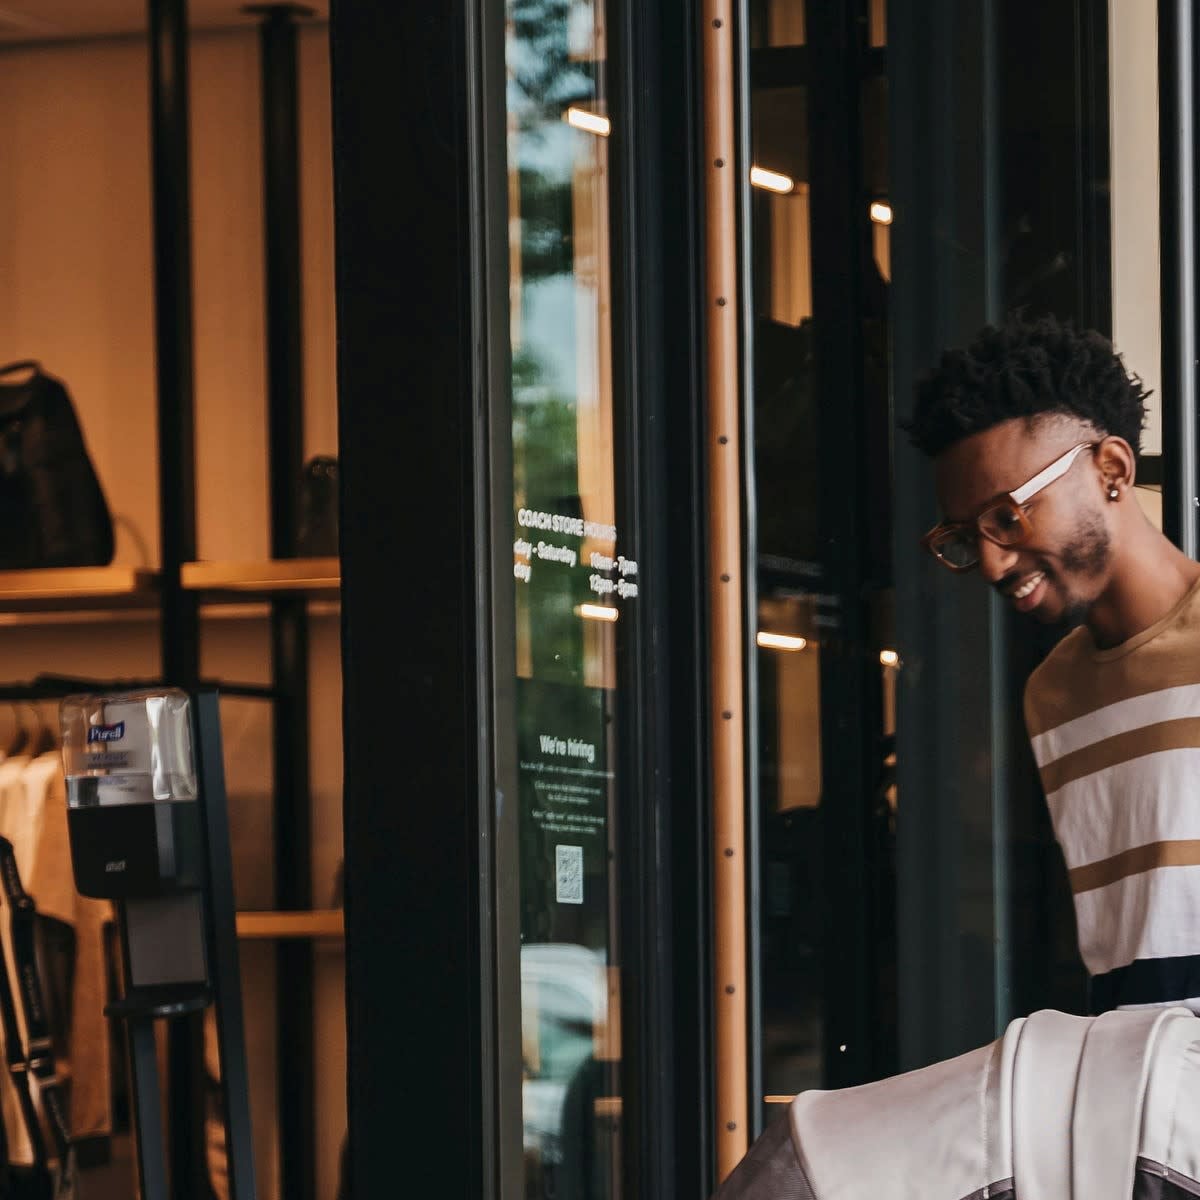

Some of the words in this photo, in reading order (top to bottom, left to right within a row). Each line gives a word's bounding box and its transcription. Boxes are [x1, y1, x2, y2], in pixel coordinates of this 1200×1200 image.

[518, 508, 552, 531] COACH
[552, 514, 584, 536] STORE
[584, 520, 617, 542] HOURS
[538, 541, 577, 567] Saturday
[590, 552, 613, 570] 10am
[617, 555, 638, 576] 7pm
[589, 574, 613, 595] 12pm
[617, 578, 638, 599] 5pm
[539, 734, 567, 756] We're
[567, 738, 595, 763] hiring
